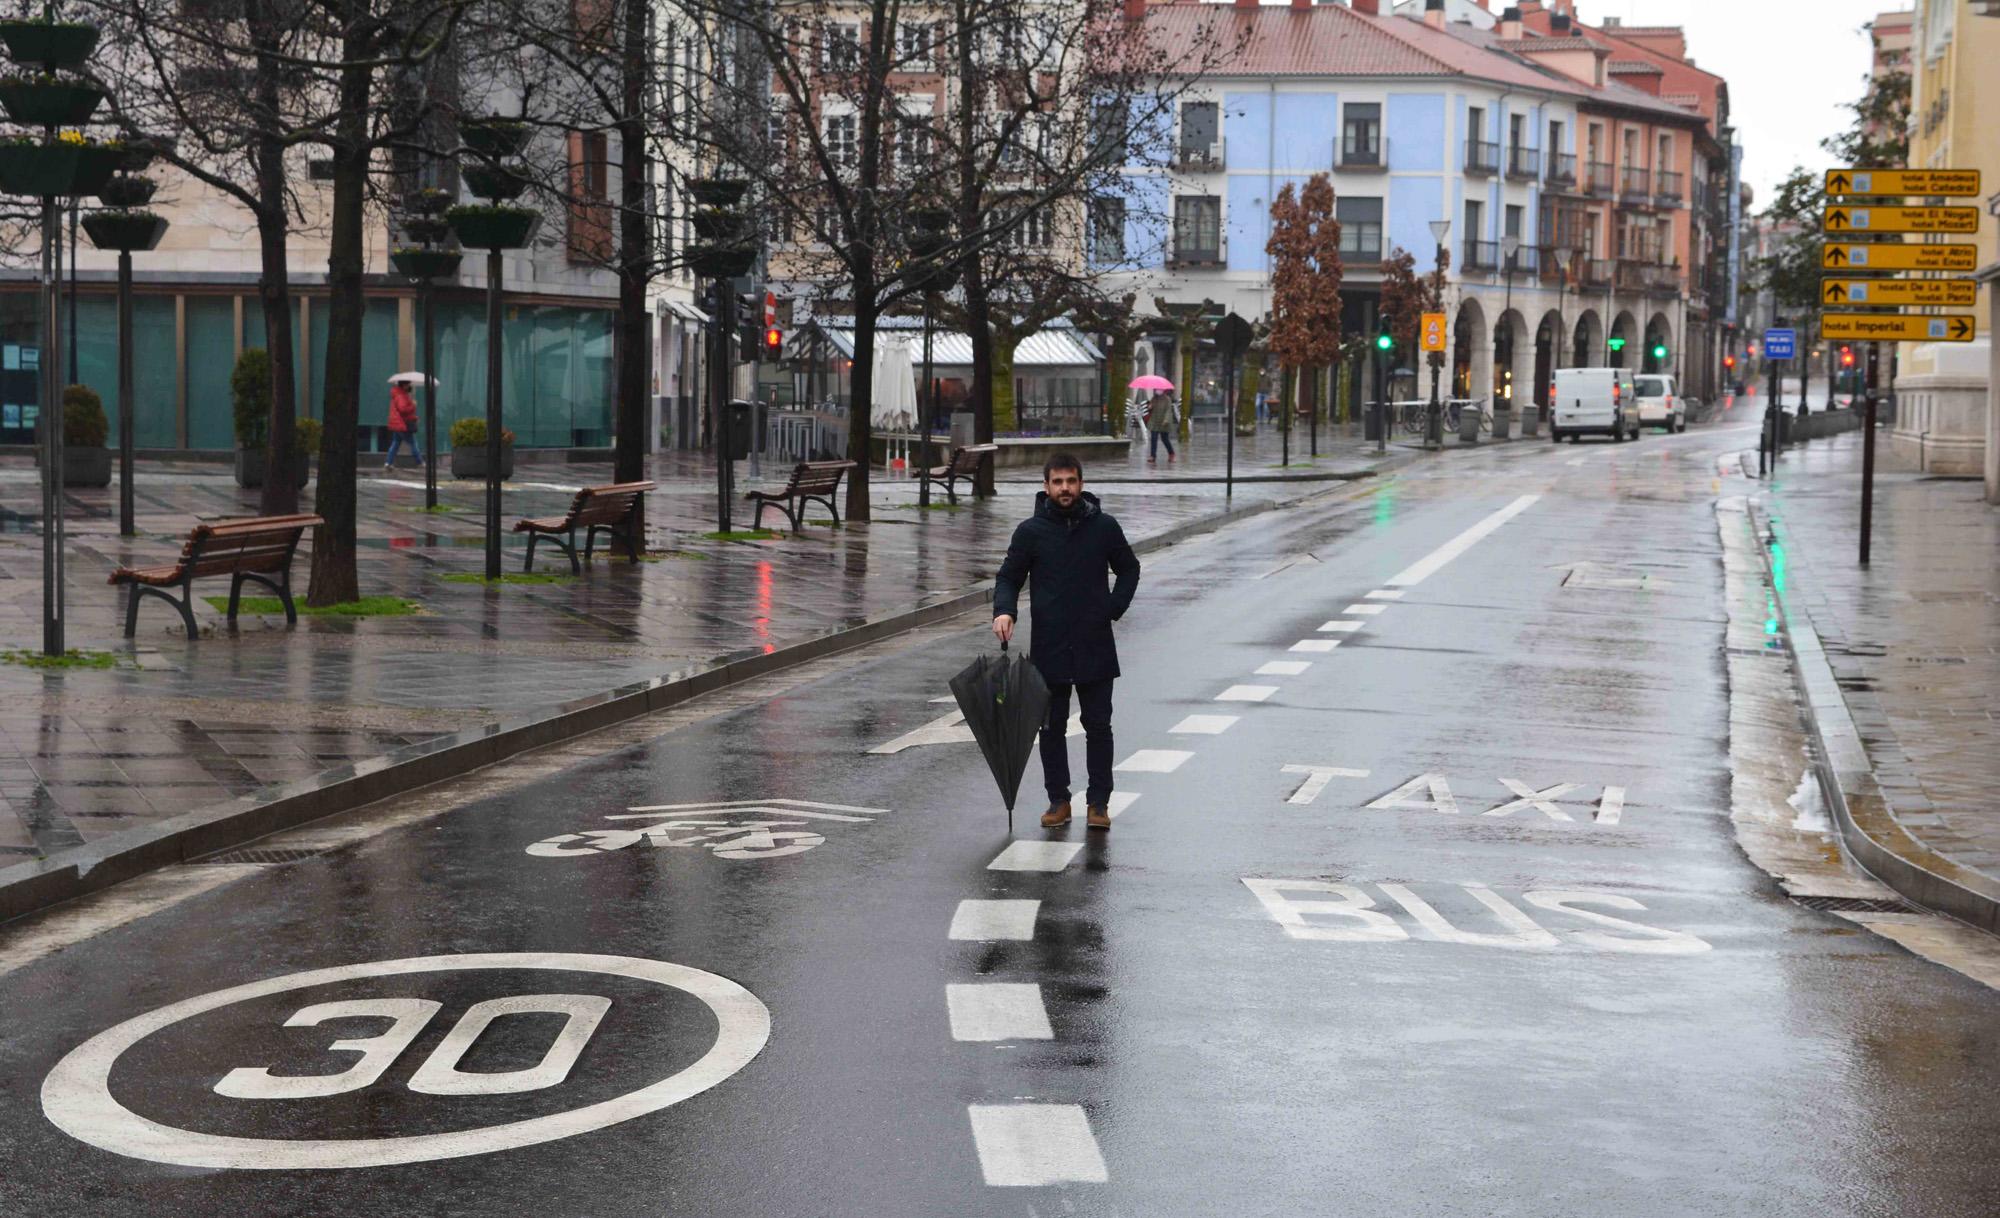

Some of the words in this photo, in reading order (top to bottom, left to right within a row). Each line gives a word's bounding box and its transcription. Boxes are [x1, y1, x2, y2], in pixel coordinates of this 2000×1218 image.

[1902, 174, 1924, 182] hotel
[1929, 174, 1975, 182] Amadeus
[1904, 184, 1926, 192] hotel
[1931, 184, 1975, 192] Catedral
[1902, 210, 1924, 218] hotel
[1929, 210, 1938, 218] El
[1944, 210, 1973, 220] Nogal
[1938, 220, 1973, 228] Mozart
[1915, 258, 1938, 266] hotel
[1910, 283, 1923, 291] De
[1948, 283, 1971, 291] Torre
[1825, 322, 1851, 330] hotel
[1855, 321, 1905, 332] Imperial
[1280, 764, 1625, 825] TAXI
[1240, 878, 1713, 954] BUS
[213, 994, 612, 1099] 30
